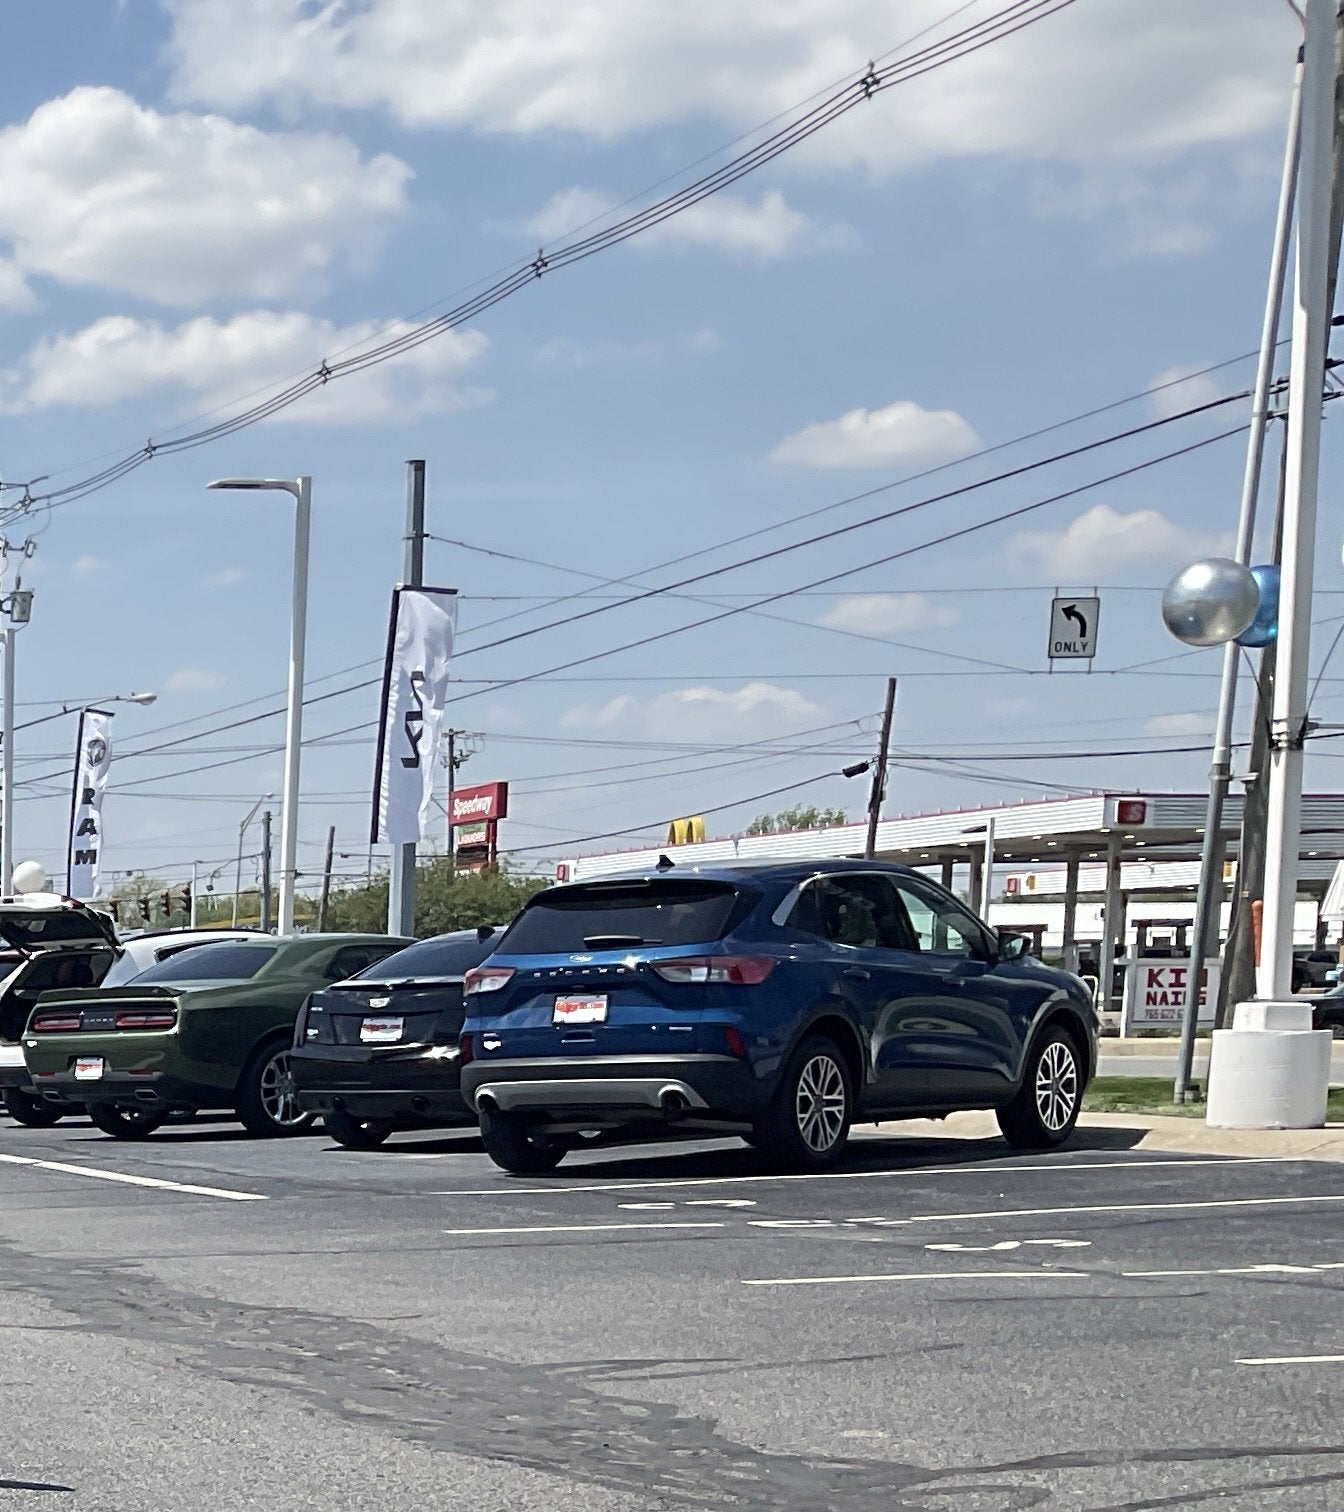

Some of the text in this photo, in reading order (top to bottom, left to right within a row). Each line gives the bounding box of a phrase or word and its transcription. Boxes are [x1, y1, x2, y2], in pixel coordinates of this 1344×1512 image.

[1054, 641, 1089, 653] ONLY
[453, 794, 493, 820] Speedway
[75, 788, 98, 865] RAM
[1147, 967, 1208, 988] KI
